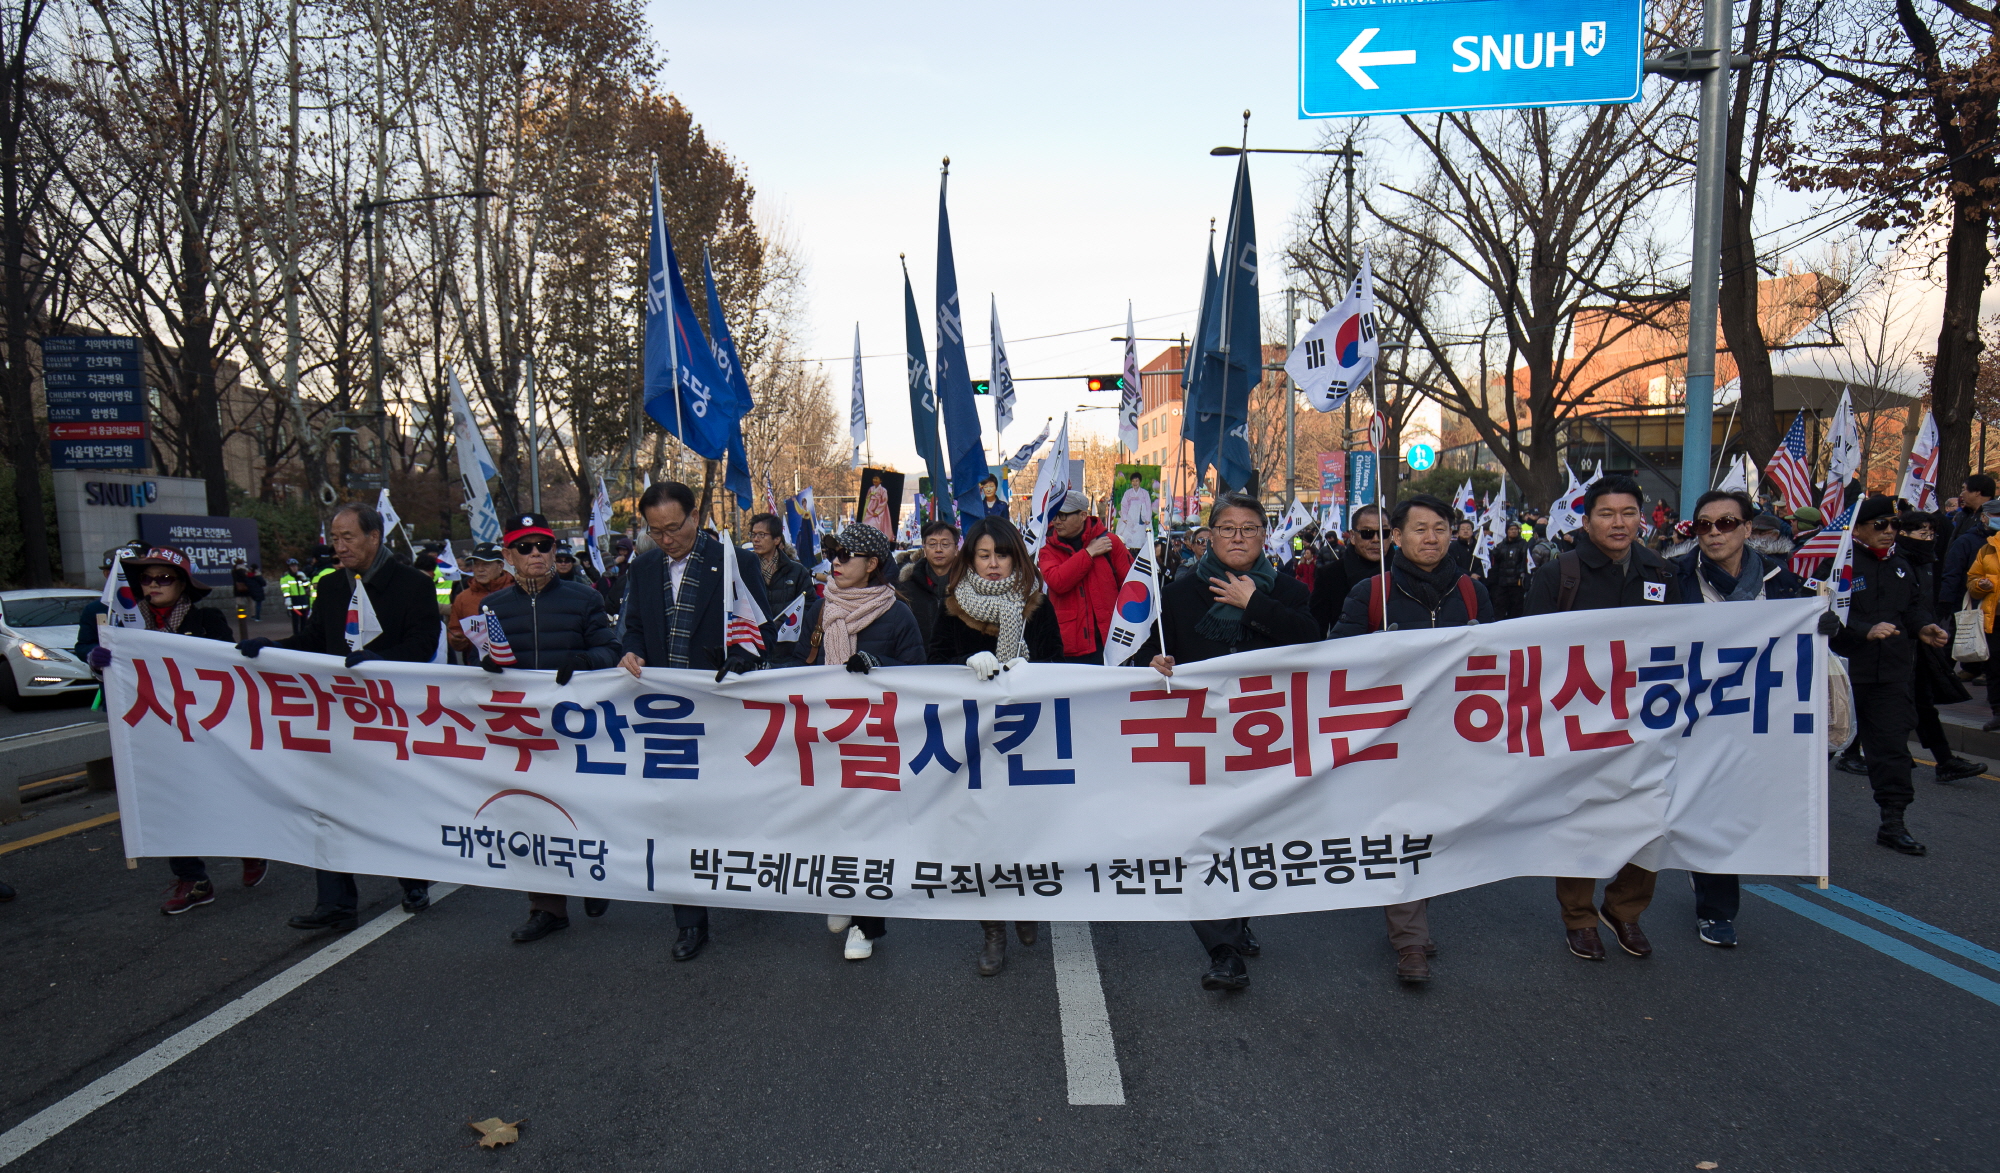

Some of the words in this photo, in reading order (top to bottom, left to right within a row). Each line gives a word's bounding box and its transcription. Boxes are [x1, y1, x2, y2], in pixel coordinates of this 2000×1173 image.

[1452, 31, 1575, 73] SNUH
[85, 339, 134, 350] 치의학대학원
[86, 356, 122, 367] 간호대학
[87, 373, 124, 385] 치과병원
[48, 391, 87, 399] CHILDREN'S
[89, 390, 133, 402] 어린이병원
[50, 408, 81, 416] CANCER
[91, 408, 119, 420] 암병원
[98, 426, 140, 436] 응급의료센터
[64, 445, 134, 459] 서울대학교병원
[1356, 455, 1364, 490] Christmas
[86, 482, 146, 507] SNUH
[169, 526, 202, 537] 서울대학교
[161, 549, 183, 565] 석방
[179, 546, 248, 567] 울대학교병원
[122, 657, 705, 780] 사기탄핵소추안을
[742, 691, 1076, 791] 가결시킨
[1121, 669, 1412, 785] 국회는
[1453, 633, 1813, 757] 해산하라!
[441, 824, 608, 882] 대한애국당
[690, 848, 895, 901] 박근혜대통령
[911, 861, 1064, 899] 무죄석방
[1085, 856, 1188, 896] 1천만
[1203, 833, 1434, 893] 서명운동본부
